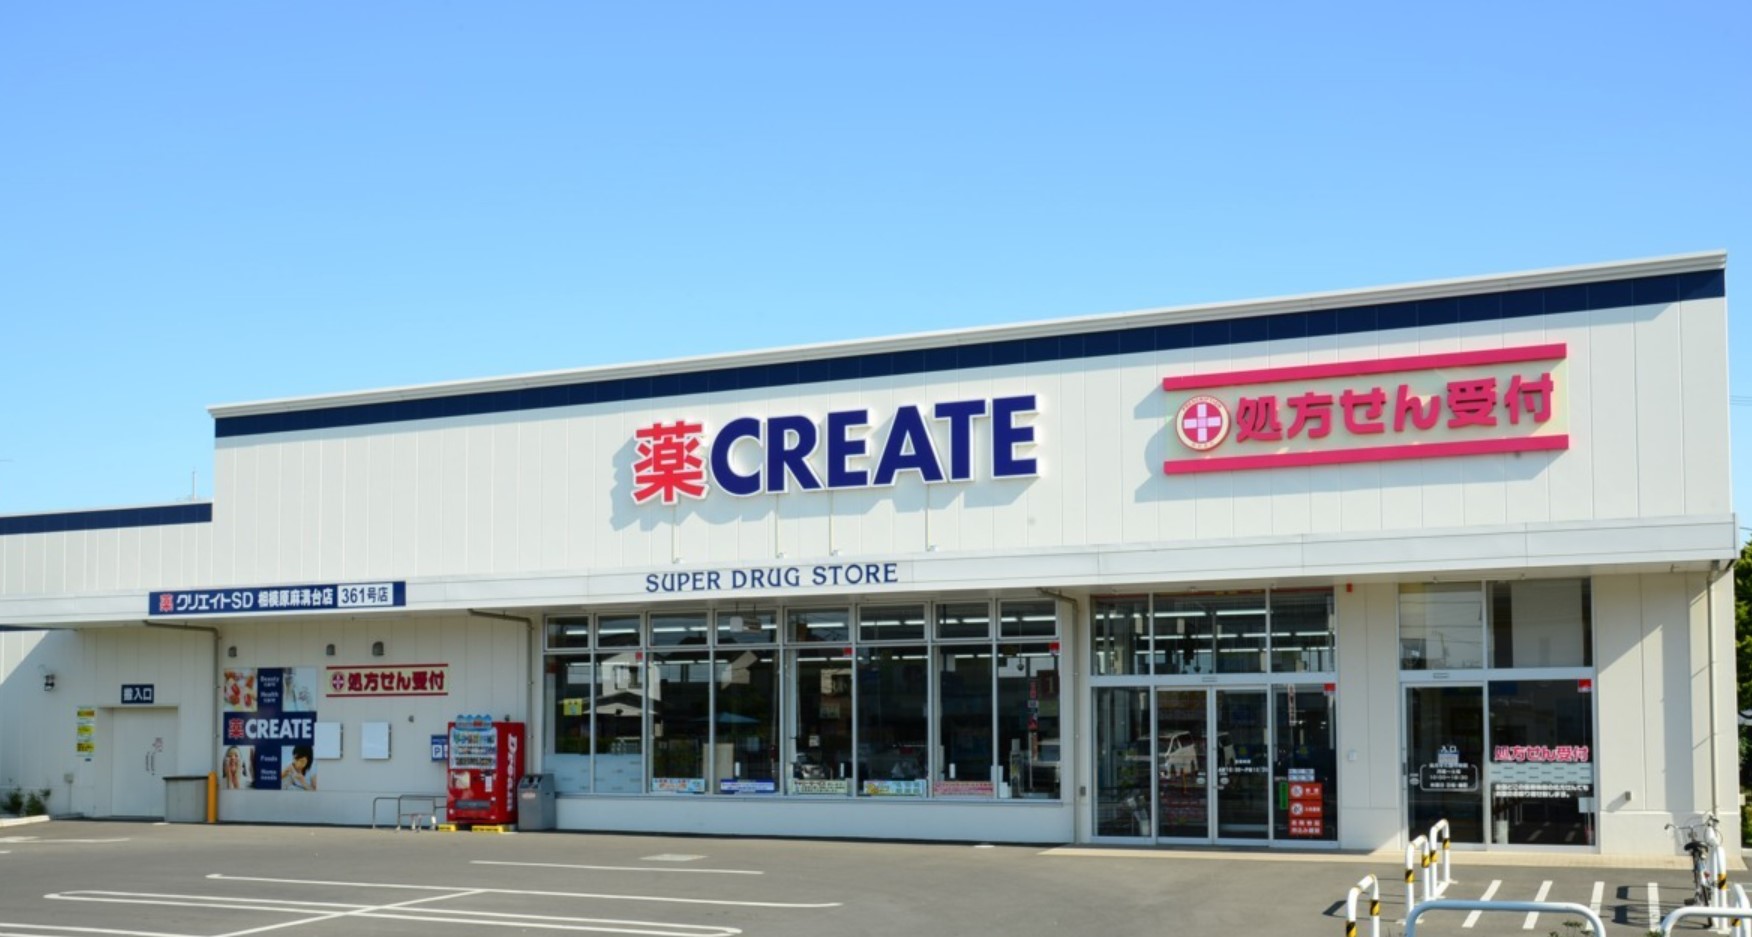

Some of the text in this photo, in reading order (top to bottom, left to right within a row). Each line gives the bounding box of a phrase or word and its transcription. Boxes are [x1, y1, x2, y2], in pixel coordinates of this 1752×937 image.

[1236, 372, 1554, 444] 処方せん受付
[711, 394, 1037, 495] CREATE
[646, 563, 898, 593] SUPER DRUG STORE
[176, 591, 254, 611] クリエイトSD
[342, 587, 389, 604] 361号店
[348, 669, 445, 691] 処方せん受付
[245, 718, 312, 739] CREATE
[1494, 745, 1589, 762] 処方せん受付
